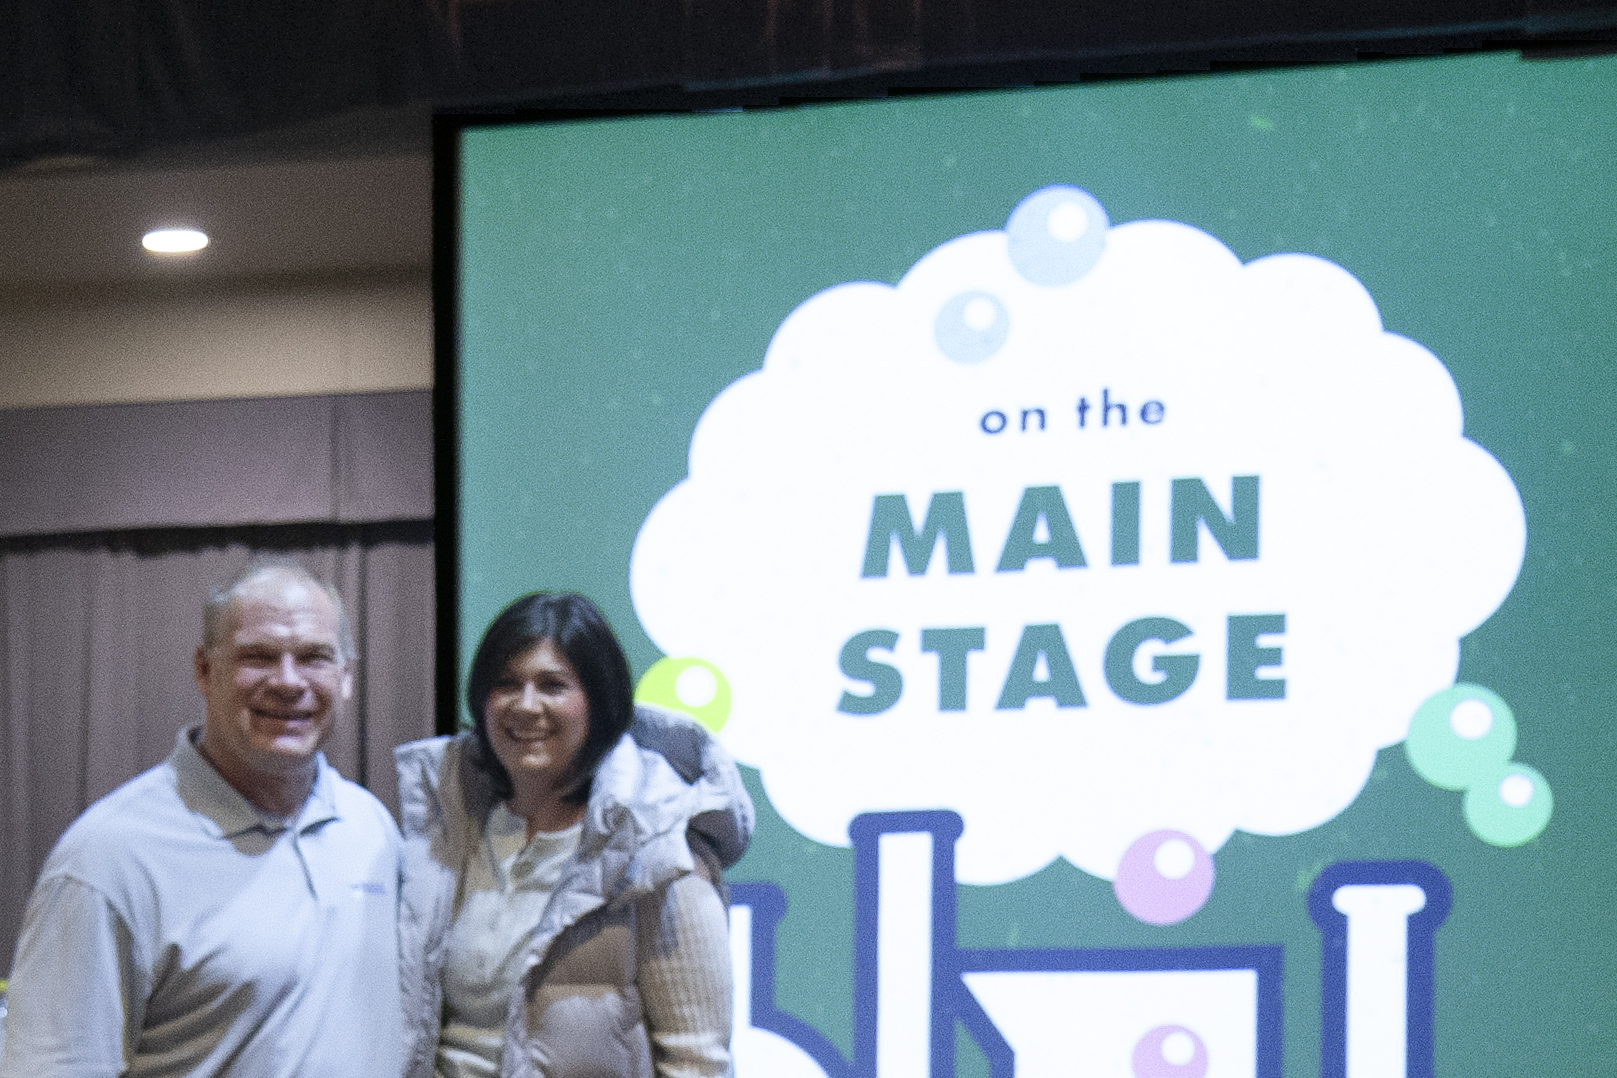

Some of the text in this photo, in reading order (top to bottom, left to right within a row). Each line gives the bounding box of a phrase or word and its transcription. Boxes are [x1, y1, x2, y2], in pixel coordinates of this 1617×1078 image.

[979, 387, 1166, 436] on the
[859, 474, 1261, 580] MAIN
[835, 612, 1288, 717] STAGE
